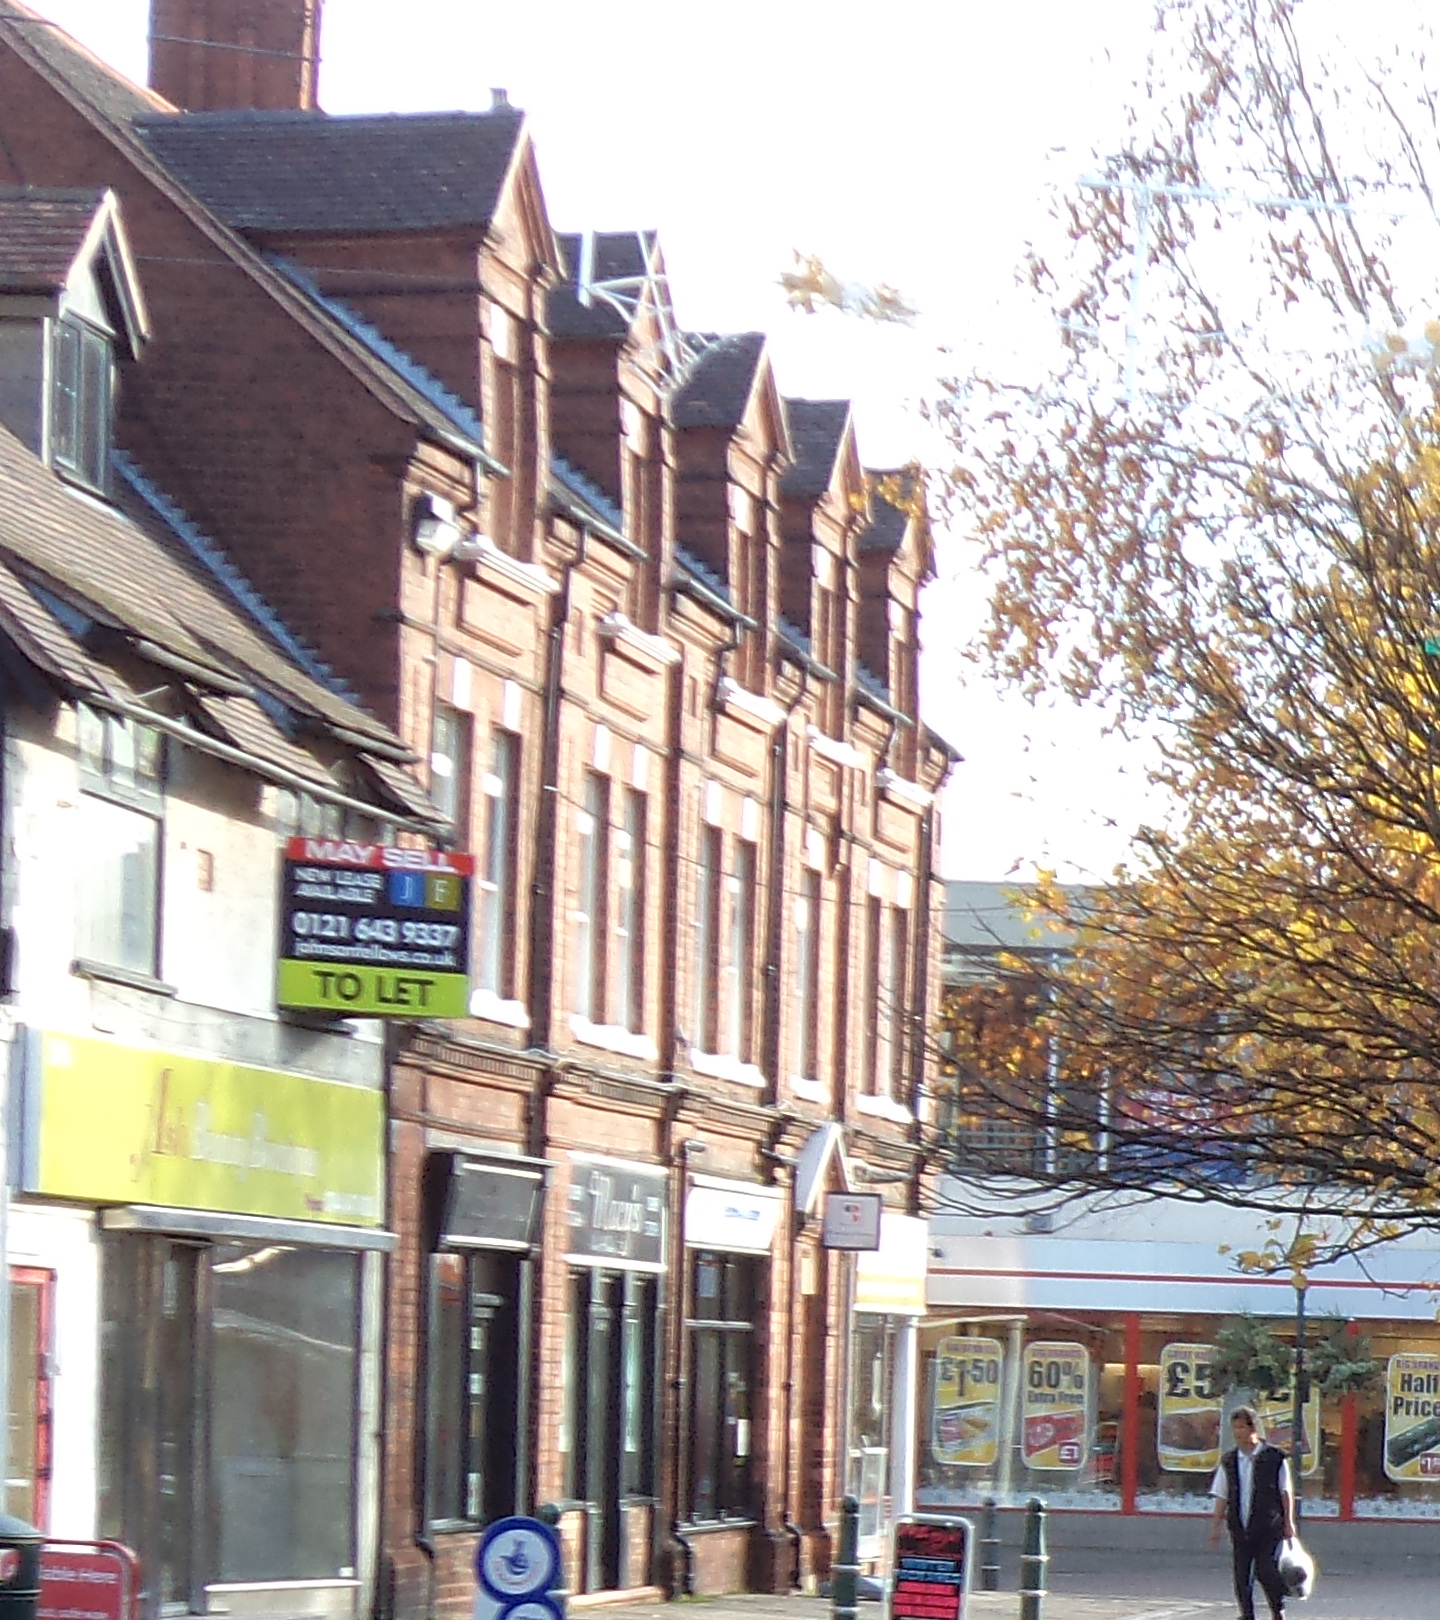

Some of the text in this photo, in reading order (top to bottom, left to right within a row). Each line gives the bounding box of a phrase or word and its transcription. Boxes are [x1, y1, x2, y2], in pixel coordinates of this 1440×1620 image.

[305, 841, 459, 873] MAY SELL
[295, 866, 384, 889] NEW LEASE
[295, 882, 376, 904] AVAILABLE
[293, 911, 460, 947] 0121 643 9337
[313, 969, 437, 1007] TO LET
[1029, 1360, 1084, 1389] 60%
[1400, 1373, 1440, 1394] Half
